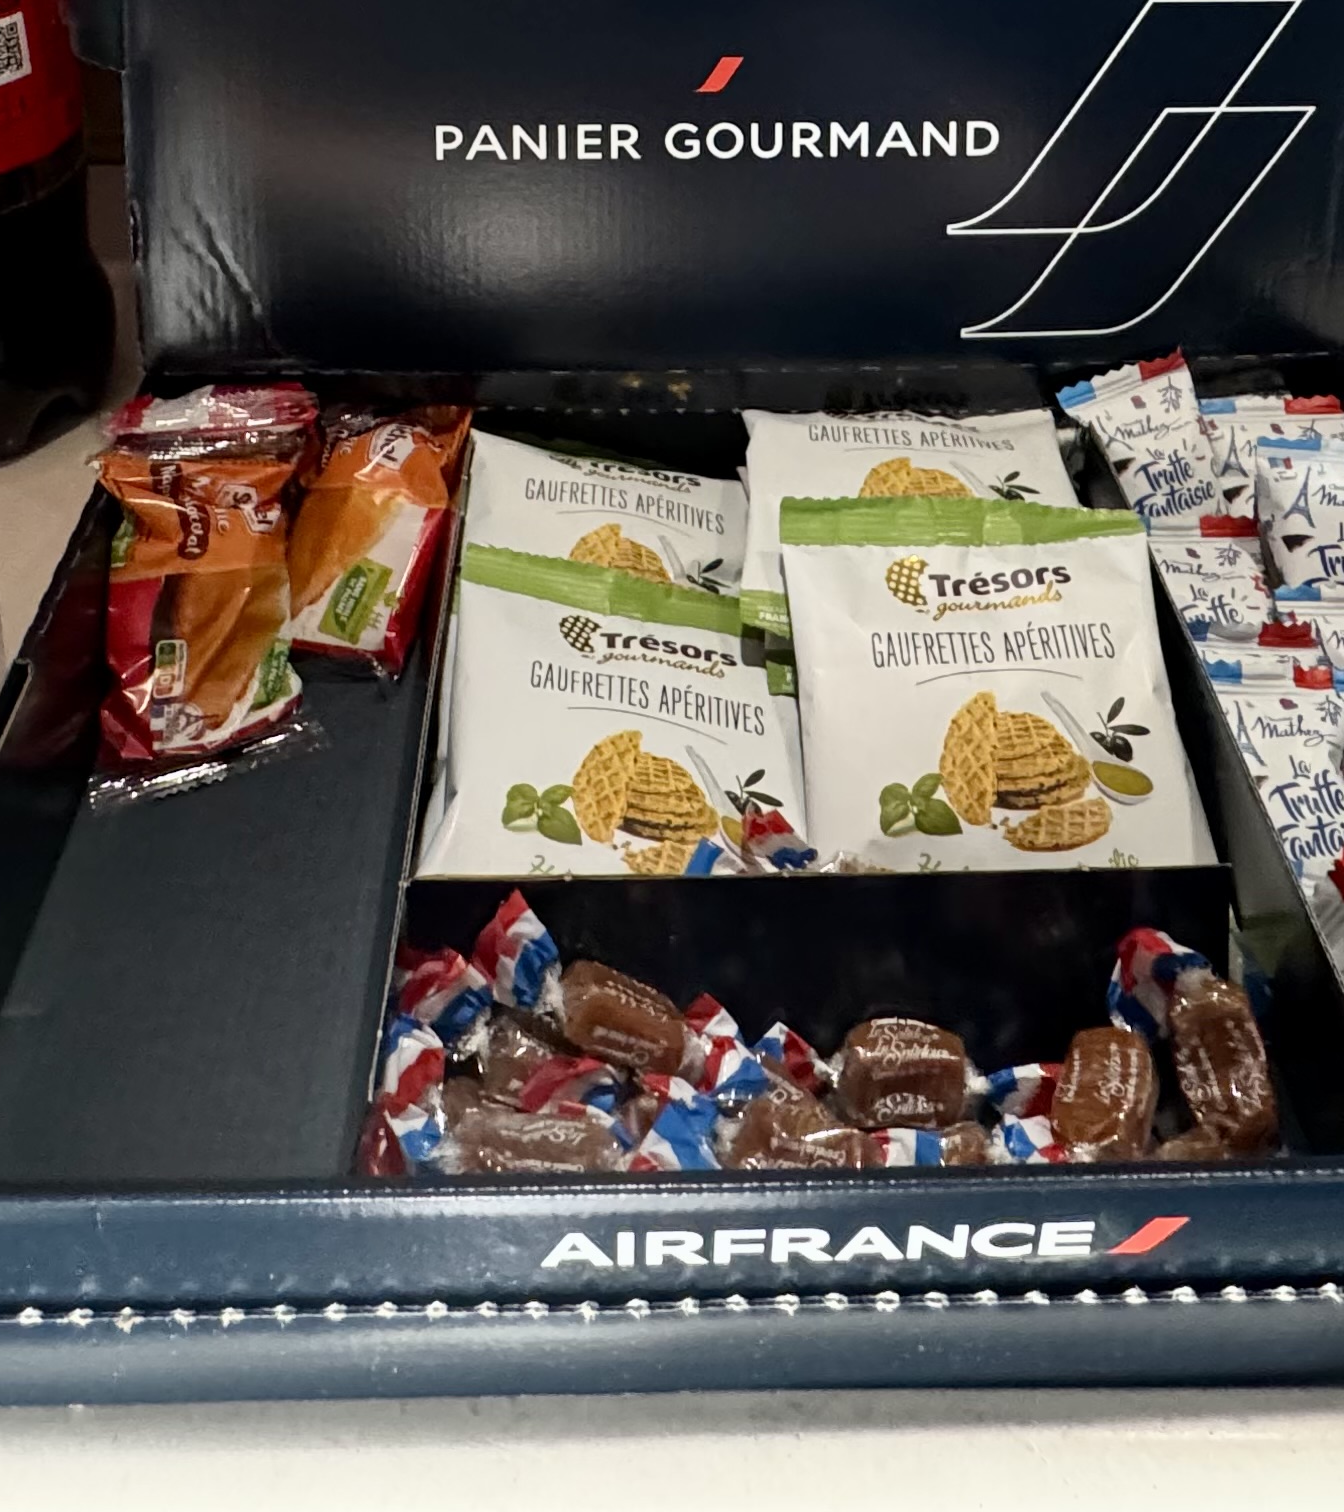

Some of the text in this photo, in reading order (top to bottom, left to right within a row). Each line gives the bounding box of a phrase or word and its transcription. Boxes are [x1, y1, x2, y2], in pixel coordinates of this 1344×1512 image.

[434, 120, 1001, 162] PANIER GOURMAND
[809, 423, 1016, 452] GAUFRETTES APÉRITIVES
[1133, 448, 1194, 493] Truffe
[524, 477, 726, 536] GAUFRETTES APÉRITIVES
[1135, 479, 1218, 519] Fantaisie
[928, 563, 1073, 599] Trésors
[932, 579, 1064, 622] gourmands
[1190, 583, 1210, 602] La
[758, 609, 790, 623] FRAN
[597, 649, 727, 679] gourmands
[599, 631, 739, 669] Trésors
[871, 620, 1117, 669] GAUFRETTES APÉRITIVES
[530, 659, 765, 736] GAUFRETTES APÉRITIVES
[1253, 713, 1328, 748] Mathez
[1288, 754, 1312, 780] La
[540, 1220, 1097, 1269] AIRFRANCE
